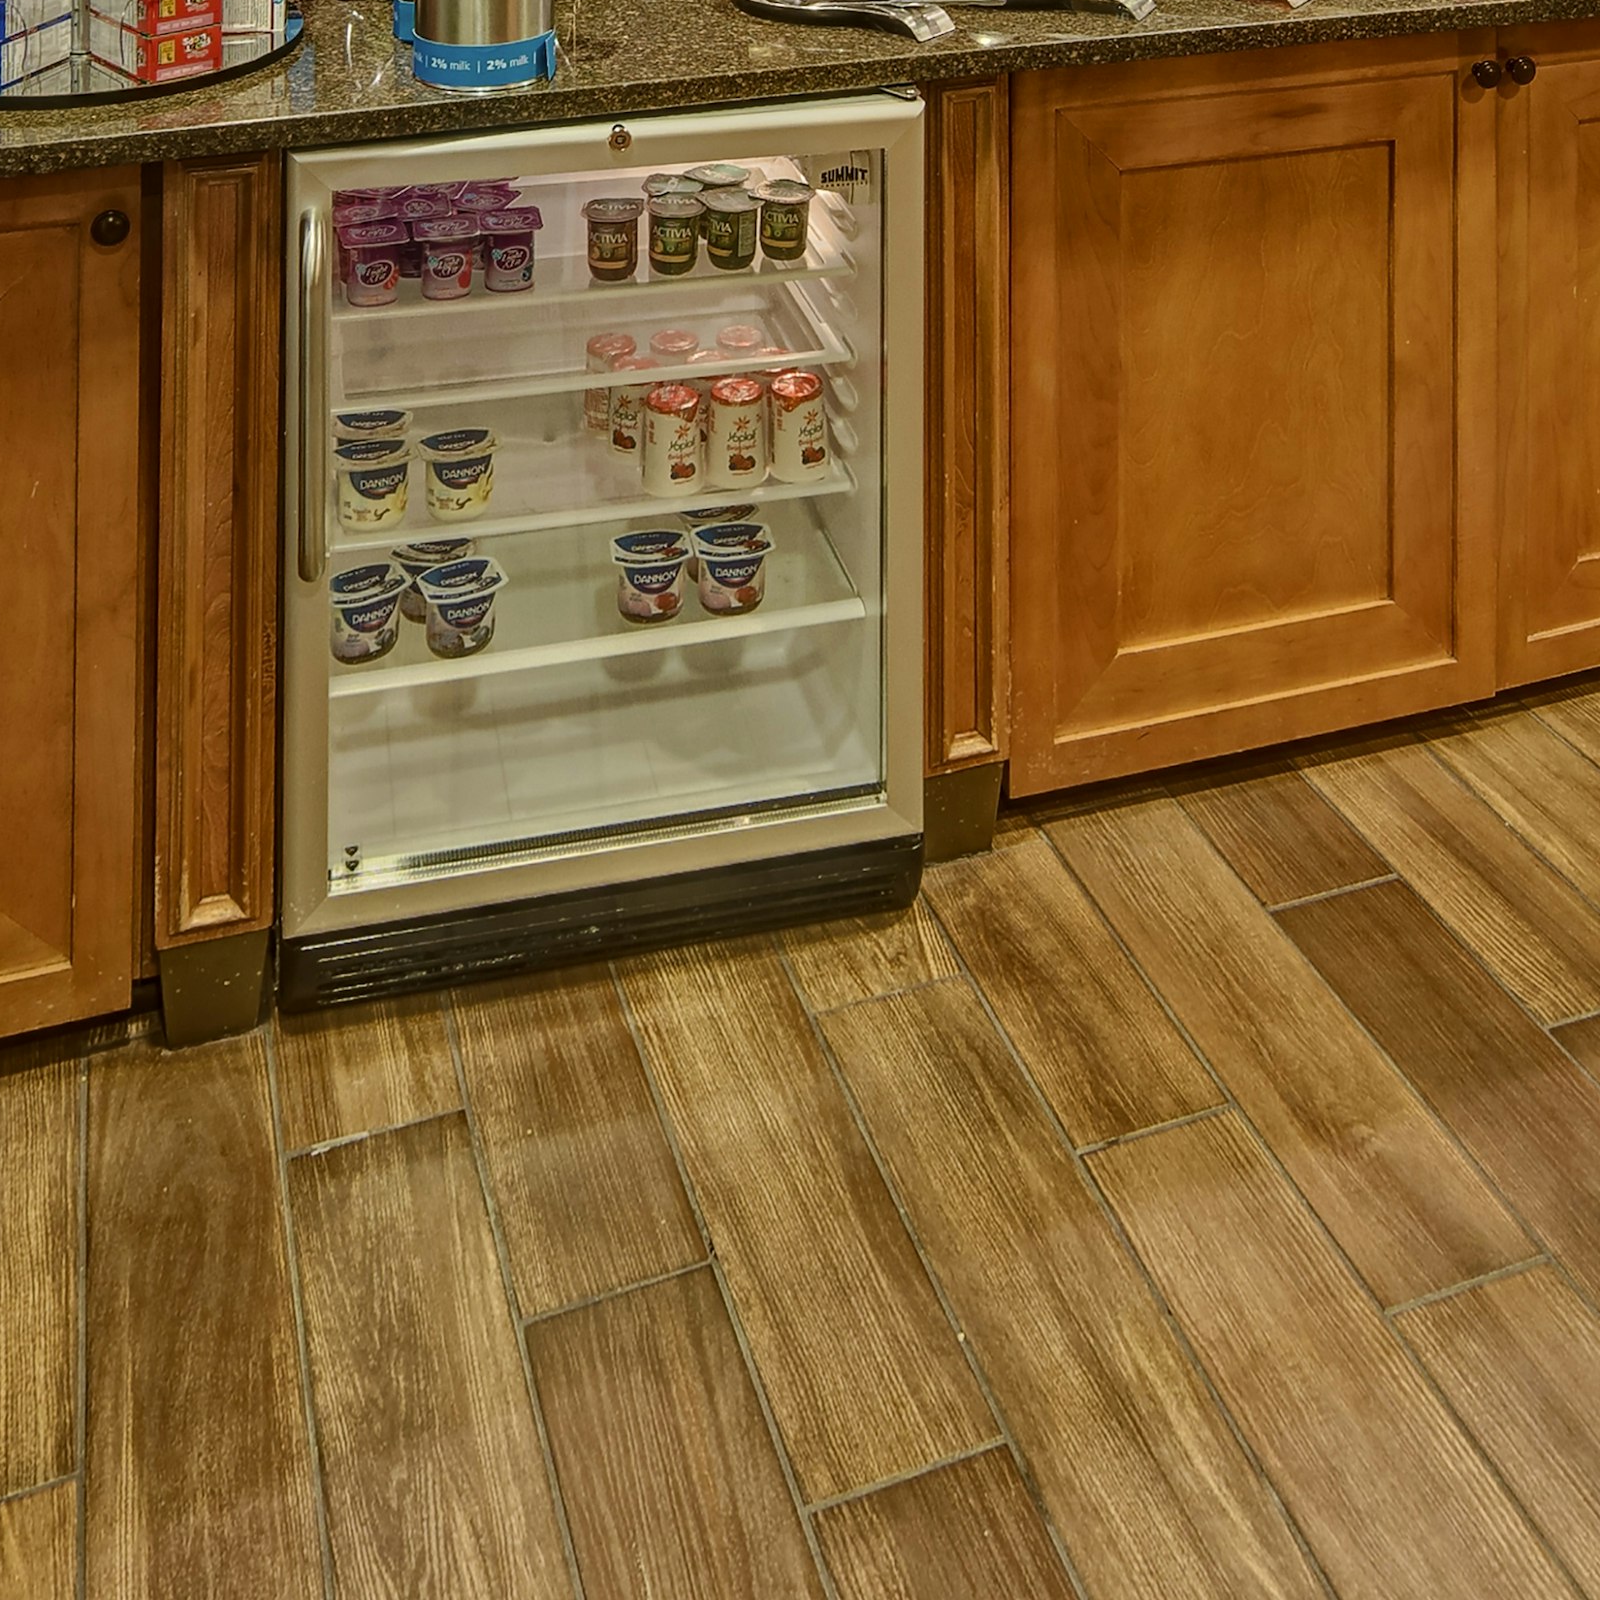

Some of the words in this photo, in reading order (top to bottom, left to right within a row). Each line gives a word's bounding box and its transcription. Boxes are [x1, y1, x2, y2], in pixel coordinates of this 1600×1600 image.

[431, 57, 447, 70] 2%
[450, 61, 471, 71] milk
[486, 58, 507, 71] 2%
[510, 55, 529, 67] milk
[821, 166, 869, 183] SUMMIT
[590, 232, 629, 244] ACTIVIA
[653, 225, 692, 239] ACTIVIA
[442, 464, 486, 480] DANNON
[360, 472, 404, 490] DANNON
[631, 542, 669, 551] DANNON
[634, 569, 677, 584] DANNON
[715, 565, 758, 577] DANNON
[343, 576, 380, 591] DANNON
[440, 572, 478, 586] DANNON
[352, 603, 395, 624] DANNON
[448, 601, 491, 619] DANNON
